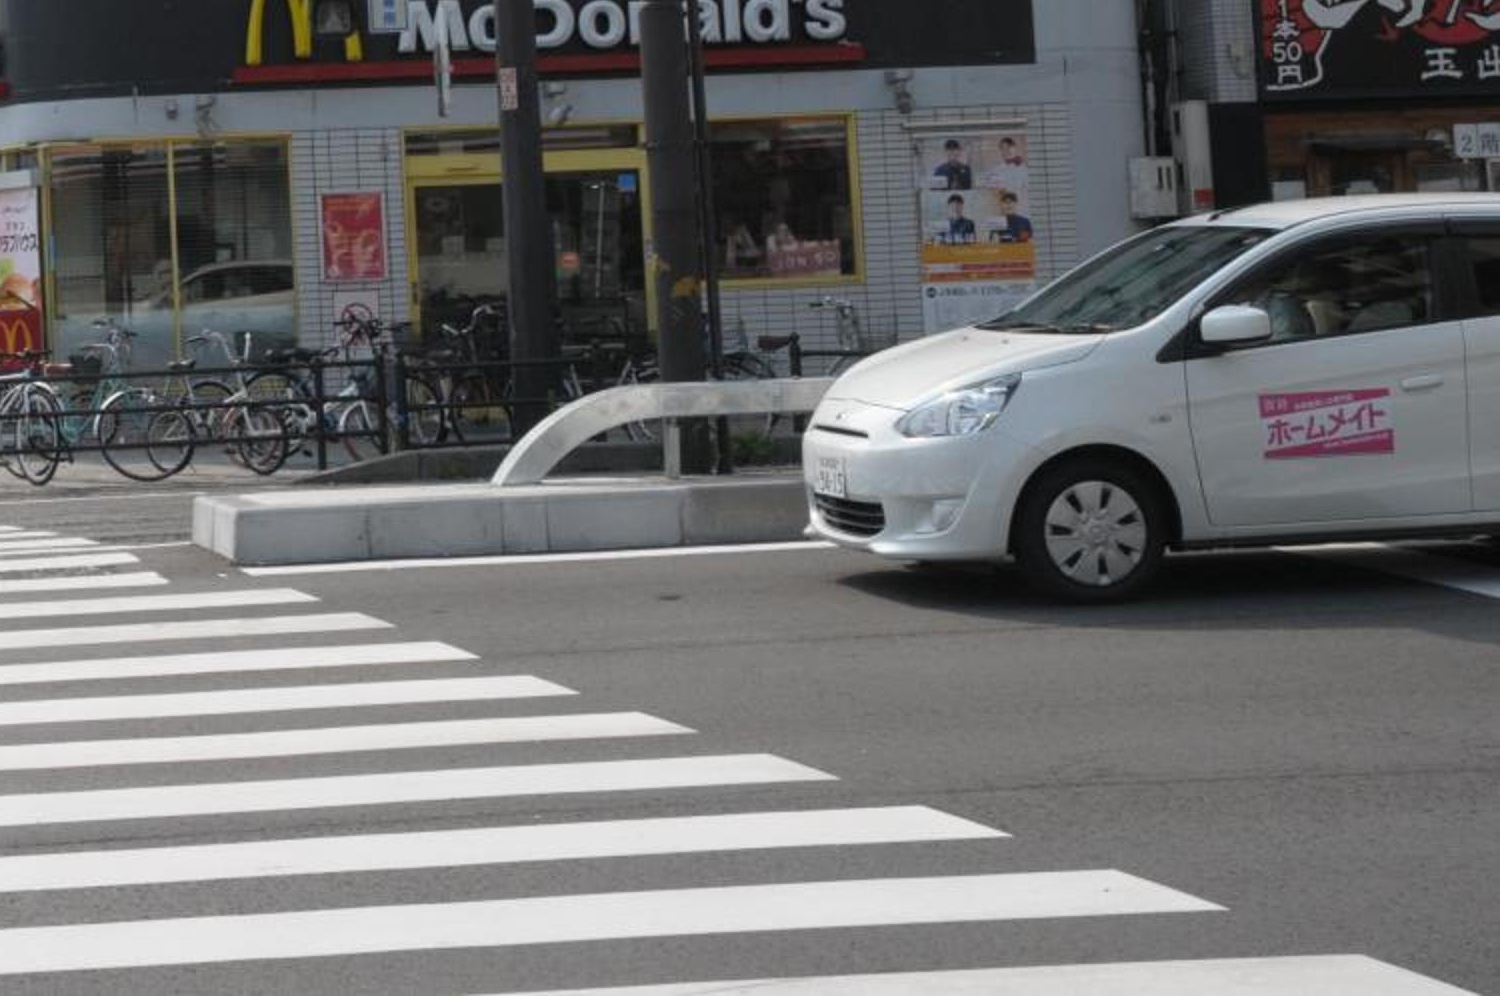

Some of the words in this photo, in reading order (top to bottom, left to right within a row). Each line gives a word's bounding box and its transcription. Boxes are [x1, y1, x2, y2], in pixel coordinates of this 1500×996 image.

[1267, 402, 1387, 446] ホームメイト
